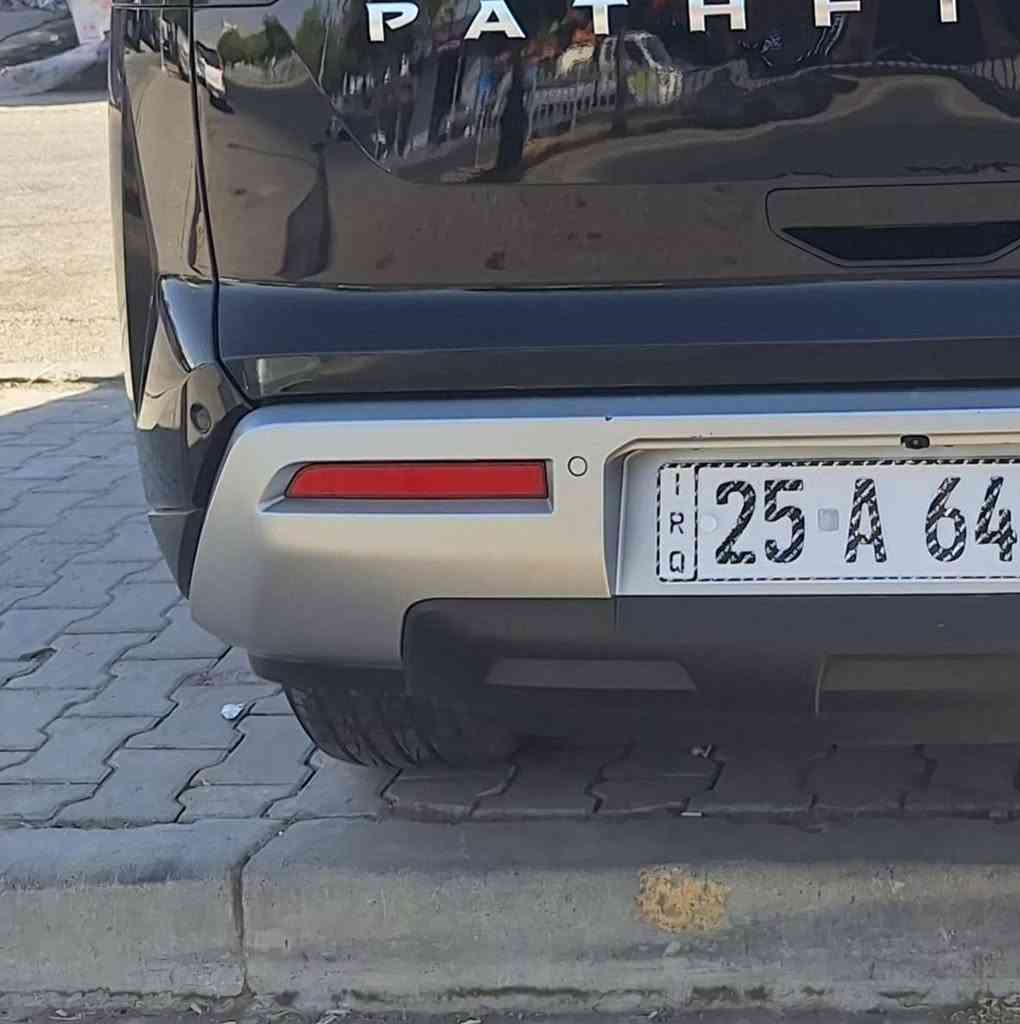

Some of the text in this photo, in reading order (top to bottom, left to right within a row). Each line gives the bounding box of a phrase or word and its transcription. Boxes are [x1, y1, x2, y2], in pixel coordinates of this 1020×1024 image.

[668, 472, 685, 574] IRQ
[714, 478, 806, 565] 25
[844, 477, 888, 563] A
